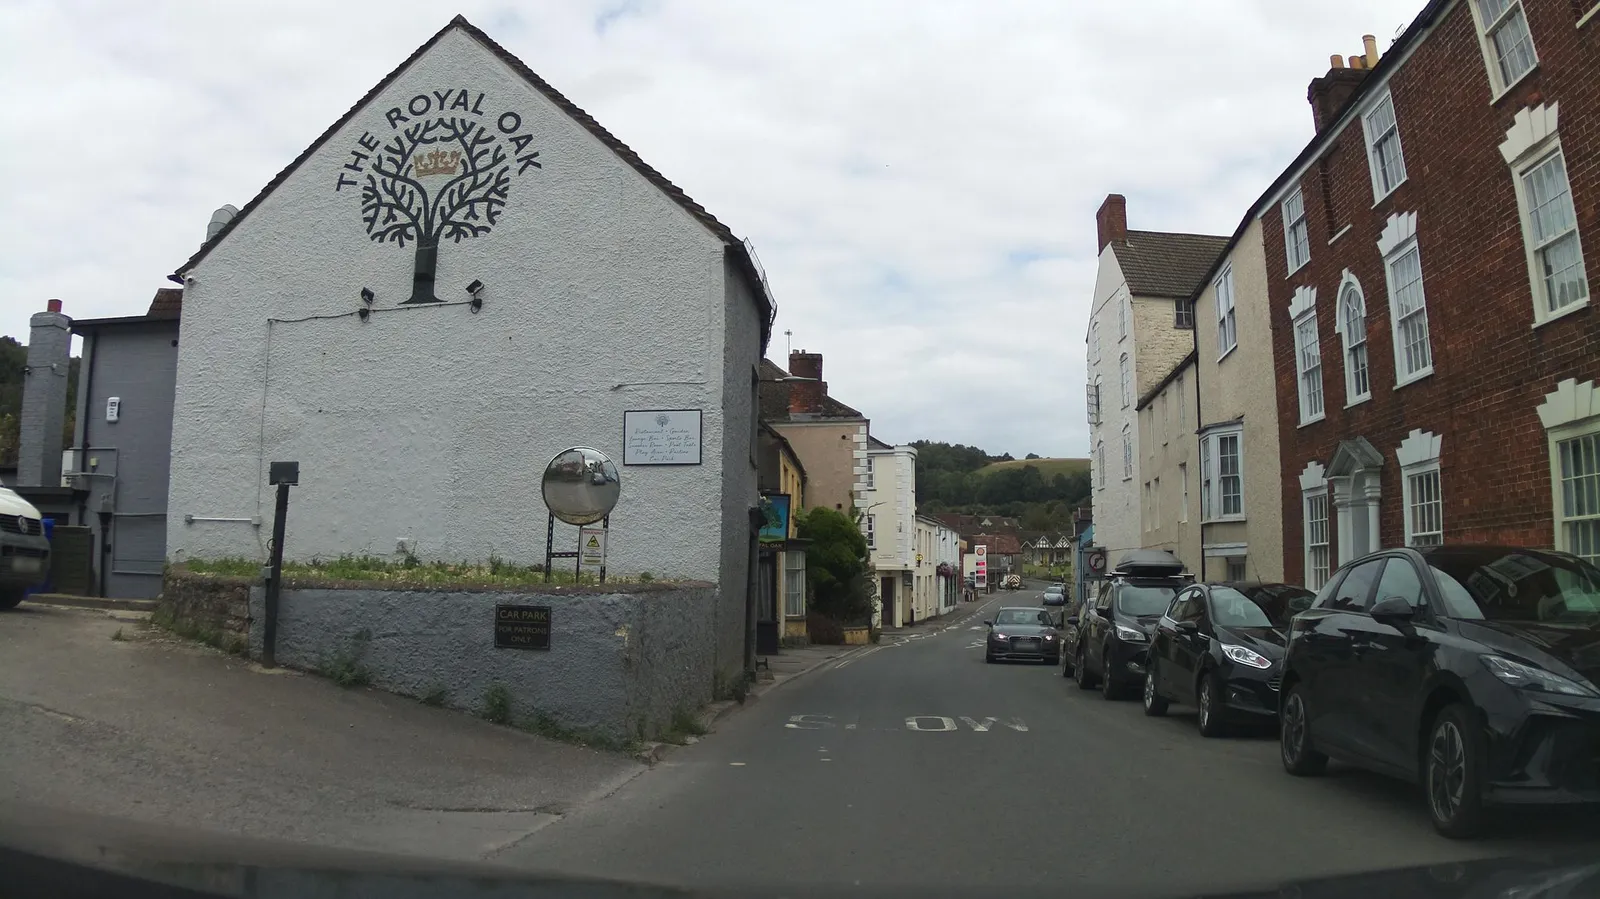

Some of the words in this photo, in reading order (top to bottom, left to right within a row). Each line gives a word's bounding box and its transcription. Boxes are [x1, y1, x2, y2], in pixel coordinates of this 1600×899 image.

[336, 131, 381, 191] THE
[385, 88, 486, 129] ROYAL
[497, 111, 542, 176] OAK
[500, 610, 520, 619] CAR
[522, 611, 547, 620] PARK
